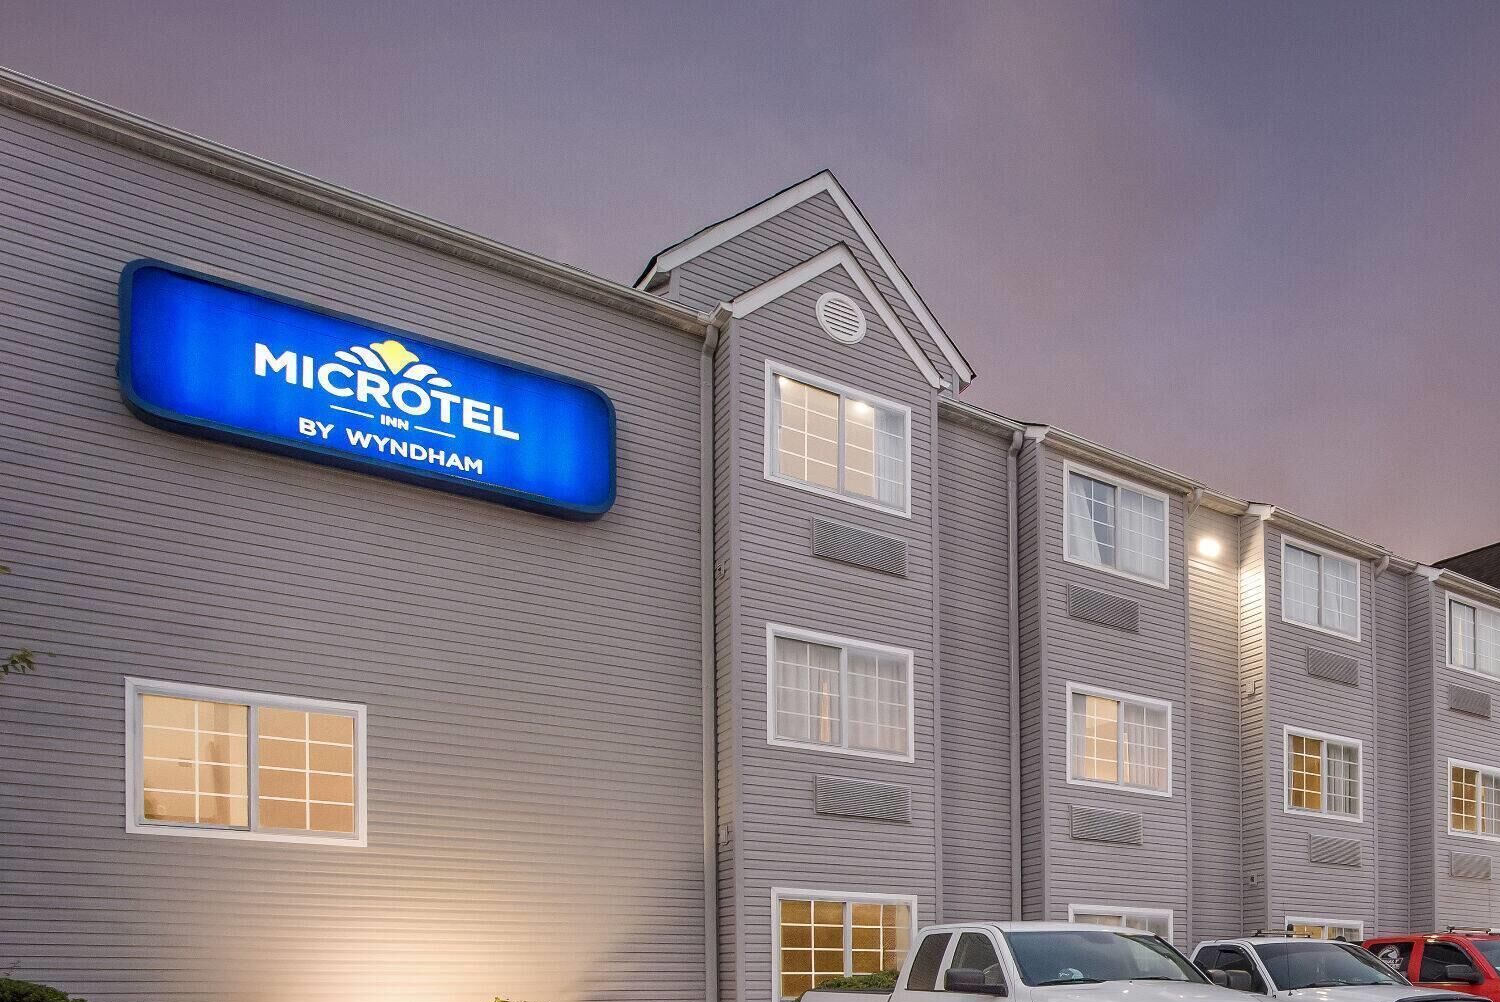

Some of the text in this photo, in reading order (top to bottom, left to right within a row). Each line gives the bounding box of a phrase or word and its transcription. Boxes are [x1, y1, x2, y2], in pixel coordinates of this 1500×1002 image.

[254, 342, 520, 441] MICROTEL
[299, 416, 483, 475] BY WYNDHAM
[380, 414, 409, 431] INN
